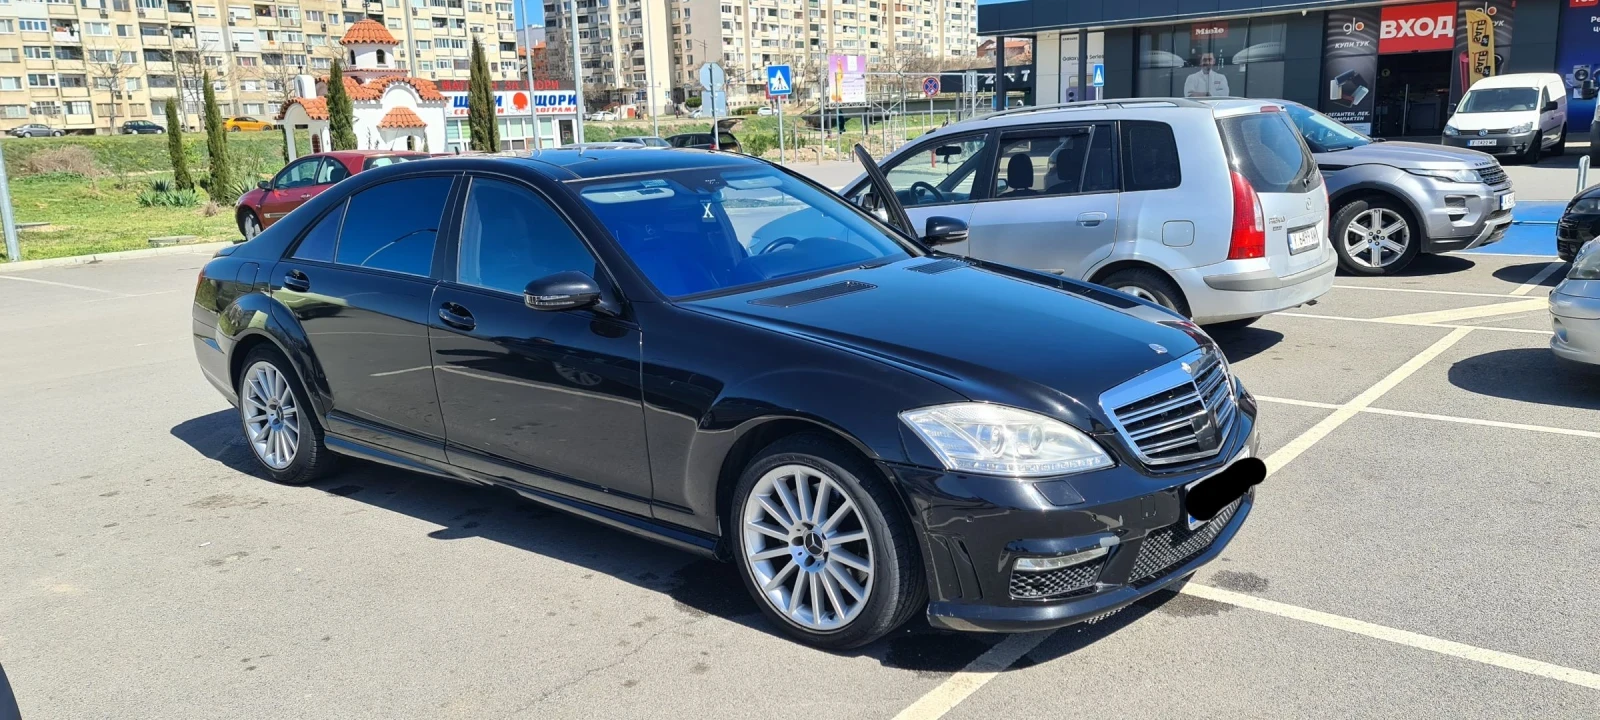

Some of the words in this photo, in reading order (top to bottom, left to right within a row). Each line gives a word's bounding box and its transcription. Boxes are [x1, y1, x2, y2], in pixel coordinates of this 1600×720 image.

[1195, 27, 1224, 35] Miele
[1343, 17, 1364, 34] glo
[1379, 15, 1454, 39] ВХОД
[1335, 41, 1355, 49] КУПИ
[442, 81, 498, 91] МАГН
[505, 81, 518, 90] ЗА
[453, 95, 503, 108] ЩИ
[534, 95, 577, 107] ЩОРИ
